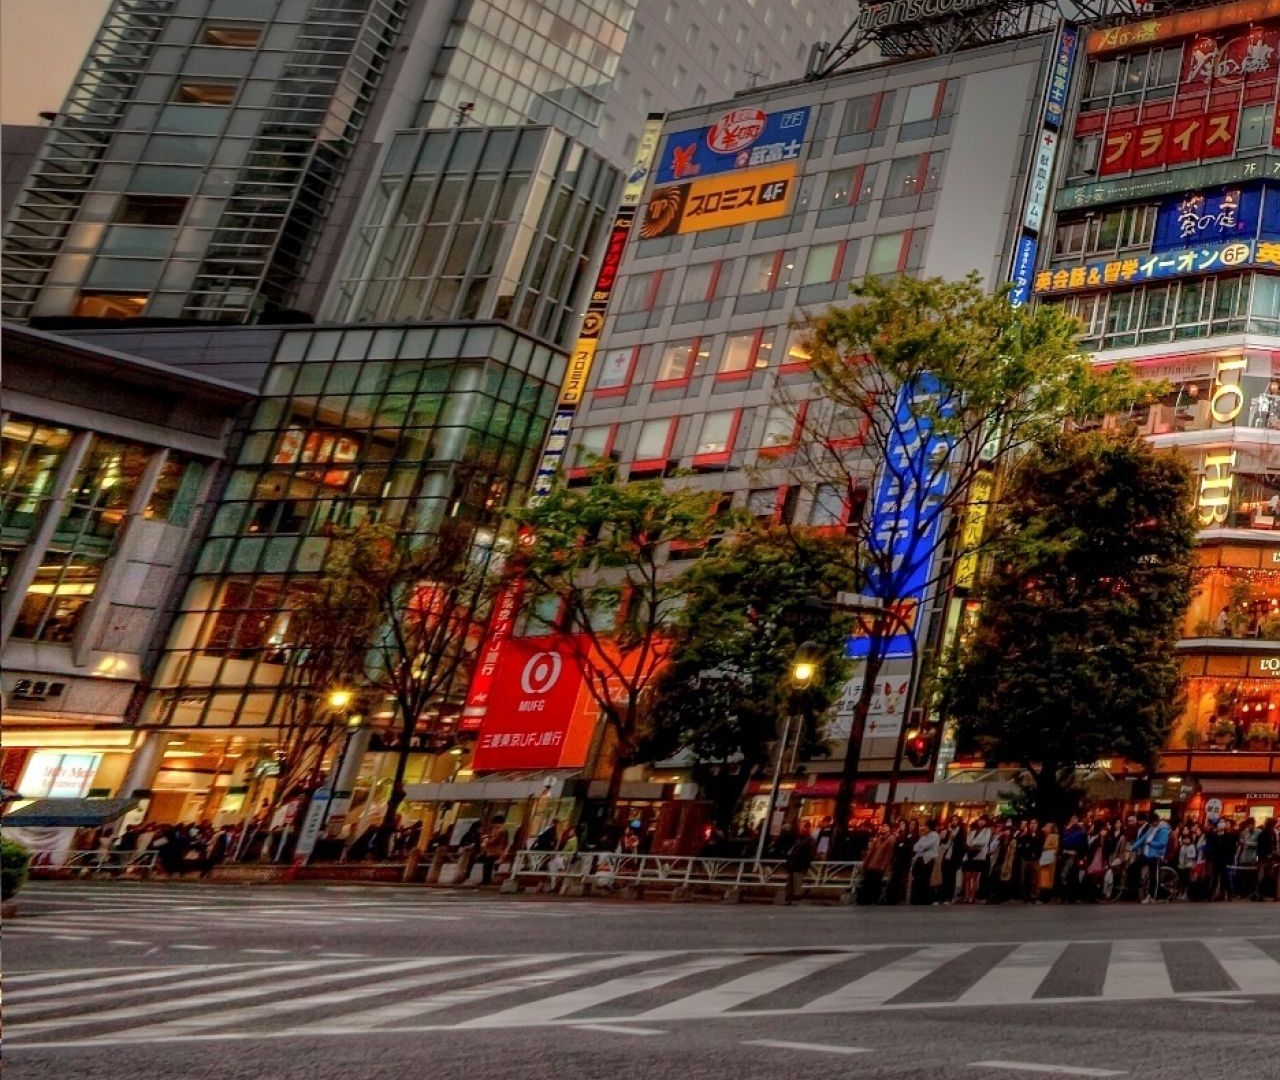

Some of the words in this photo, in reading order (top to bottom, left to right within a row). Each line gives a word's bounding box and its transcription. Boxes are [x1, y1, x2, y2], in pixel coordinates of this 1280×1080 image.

[1105, 114, 1233, 163] プライス
[751, 139, 800, 165] 武富士
[1244, 163, 1257, 175] 7F
[762, 183, 784, 201] 4F
[1224, 246, 1246, 262] 6F
[518, 700, 545, 712] MUFG
[482, 731, 562, 749] 三菱東京UFJ銀行
